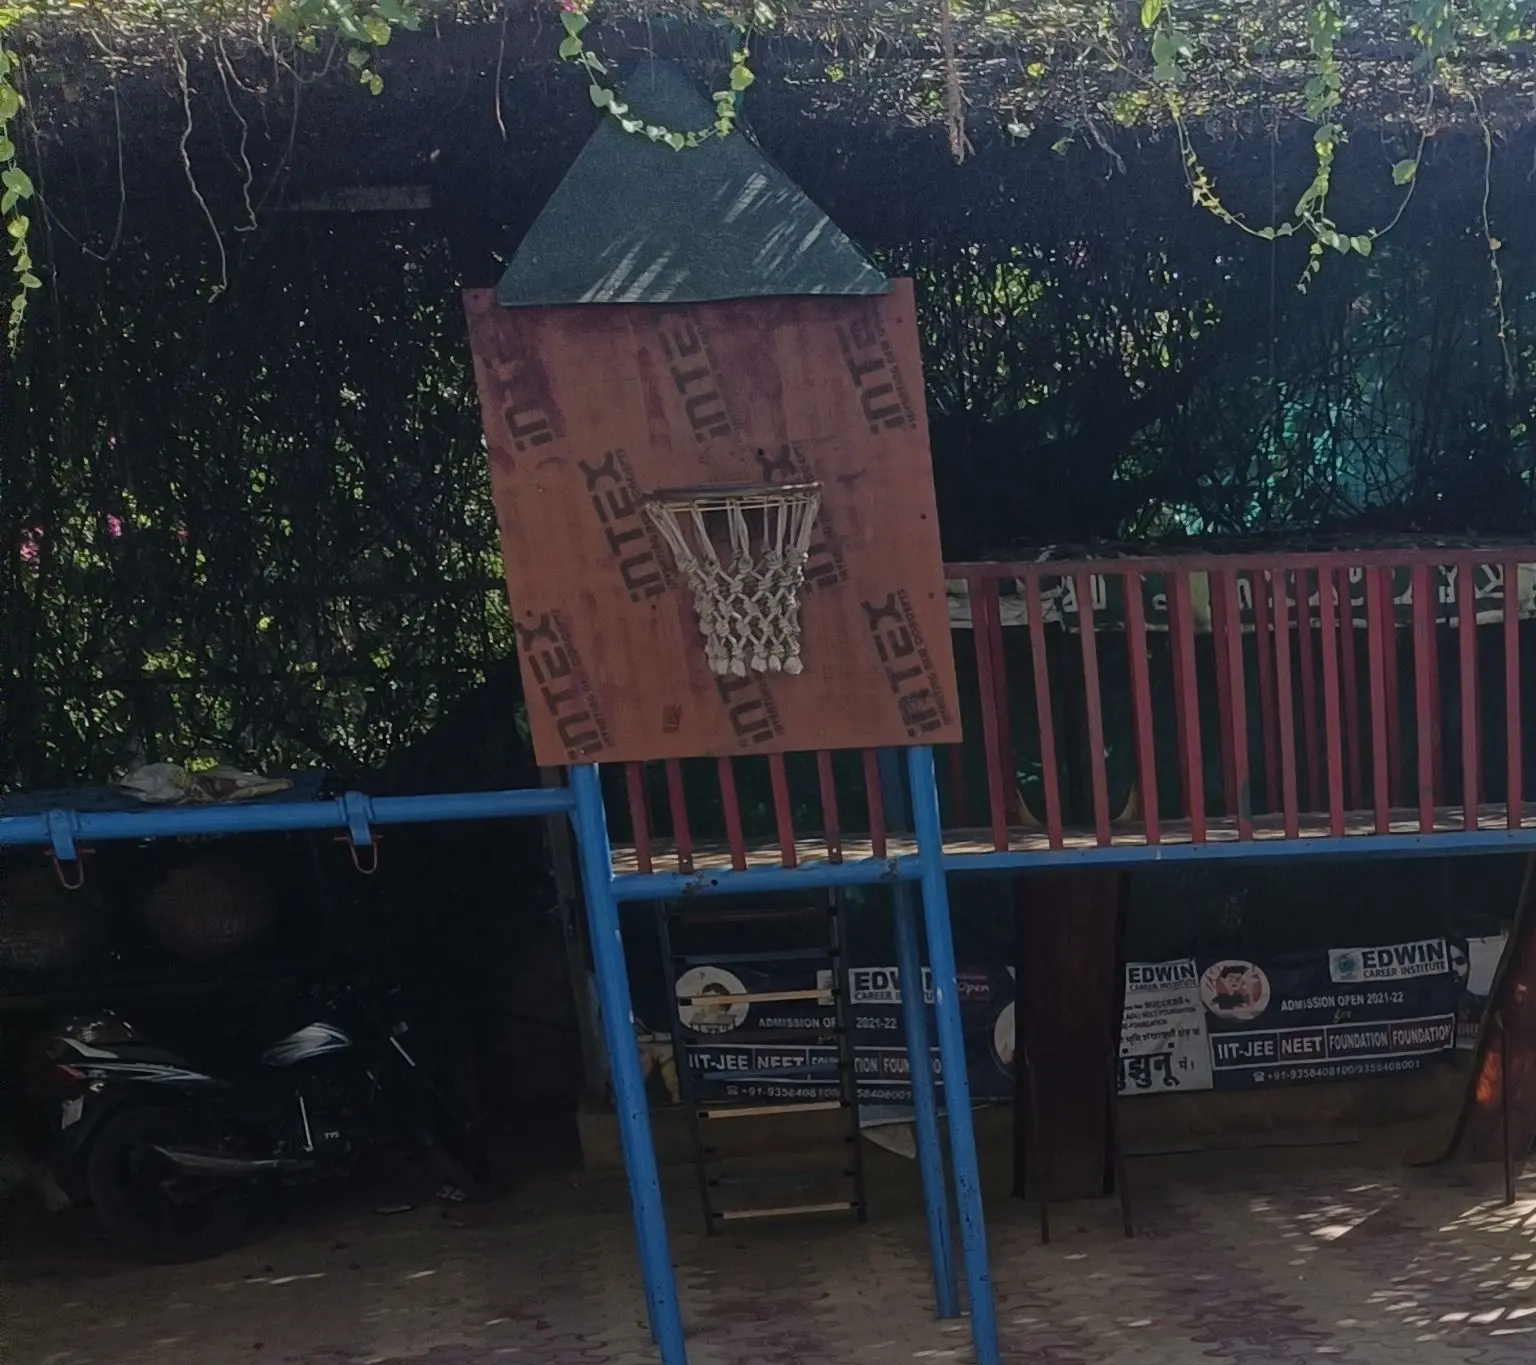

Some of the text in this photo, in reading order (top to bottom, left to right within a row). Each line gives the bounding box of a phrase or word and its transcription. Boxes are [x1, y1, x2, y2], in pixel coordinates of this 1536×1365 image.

[658, 323, 733, 443] inTE
[837, 312, 906, 436] inTE
[1362, 943, 1443, 969] EDWIN
[1129, 964, 1196, 983] EDWIN
[1364, 960, 1445, 978] CAREER INSTITUTE
[1281, 992, 1404, 1012] ADMISSION OPEN 2021-22
[758, 1016, 820, 1029] ADMISSION
[856, 1017, 897, 1030] 2021-22
[1219, 1038, 1273, 1059] IIT-JEE
[1282, 1036, 1322, 1054] NEET
[1329, 1030, 1388, 1050] FOUNDATION
[689, 1053, 749, 1071] IIT-JEE
